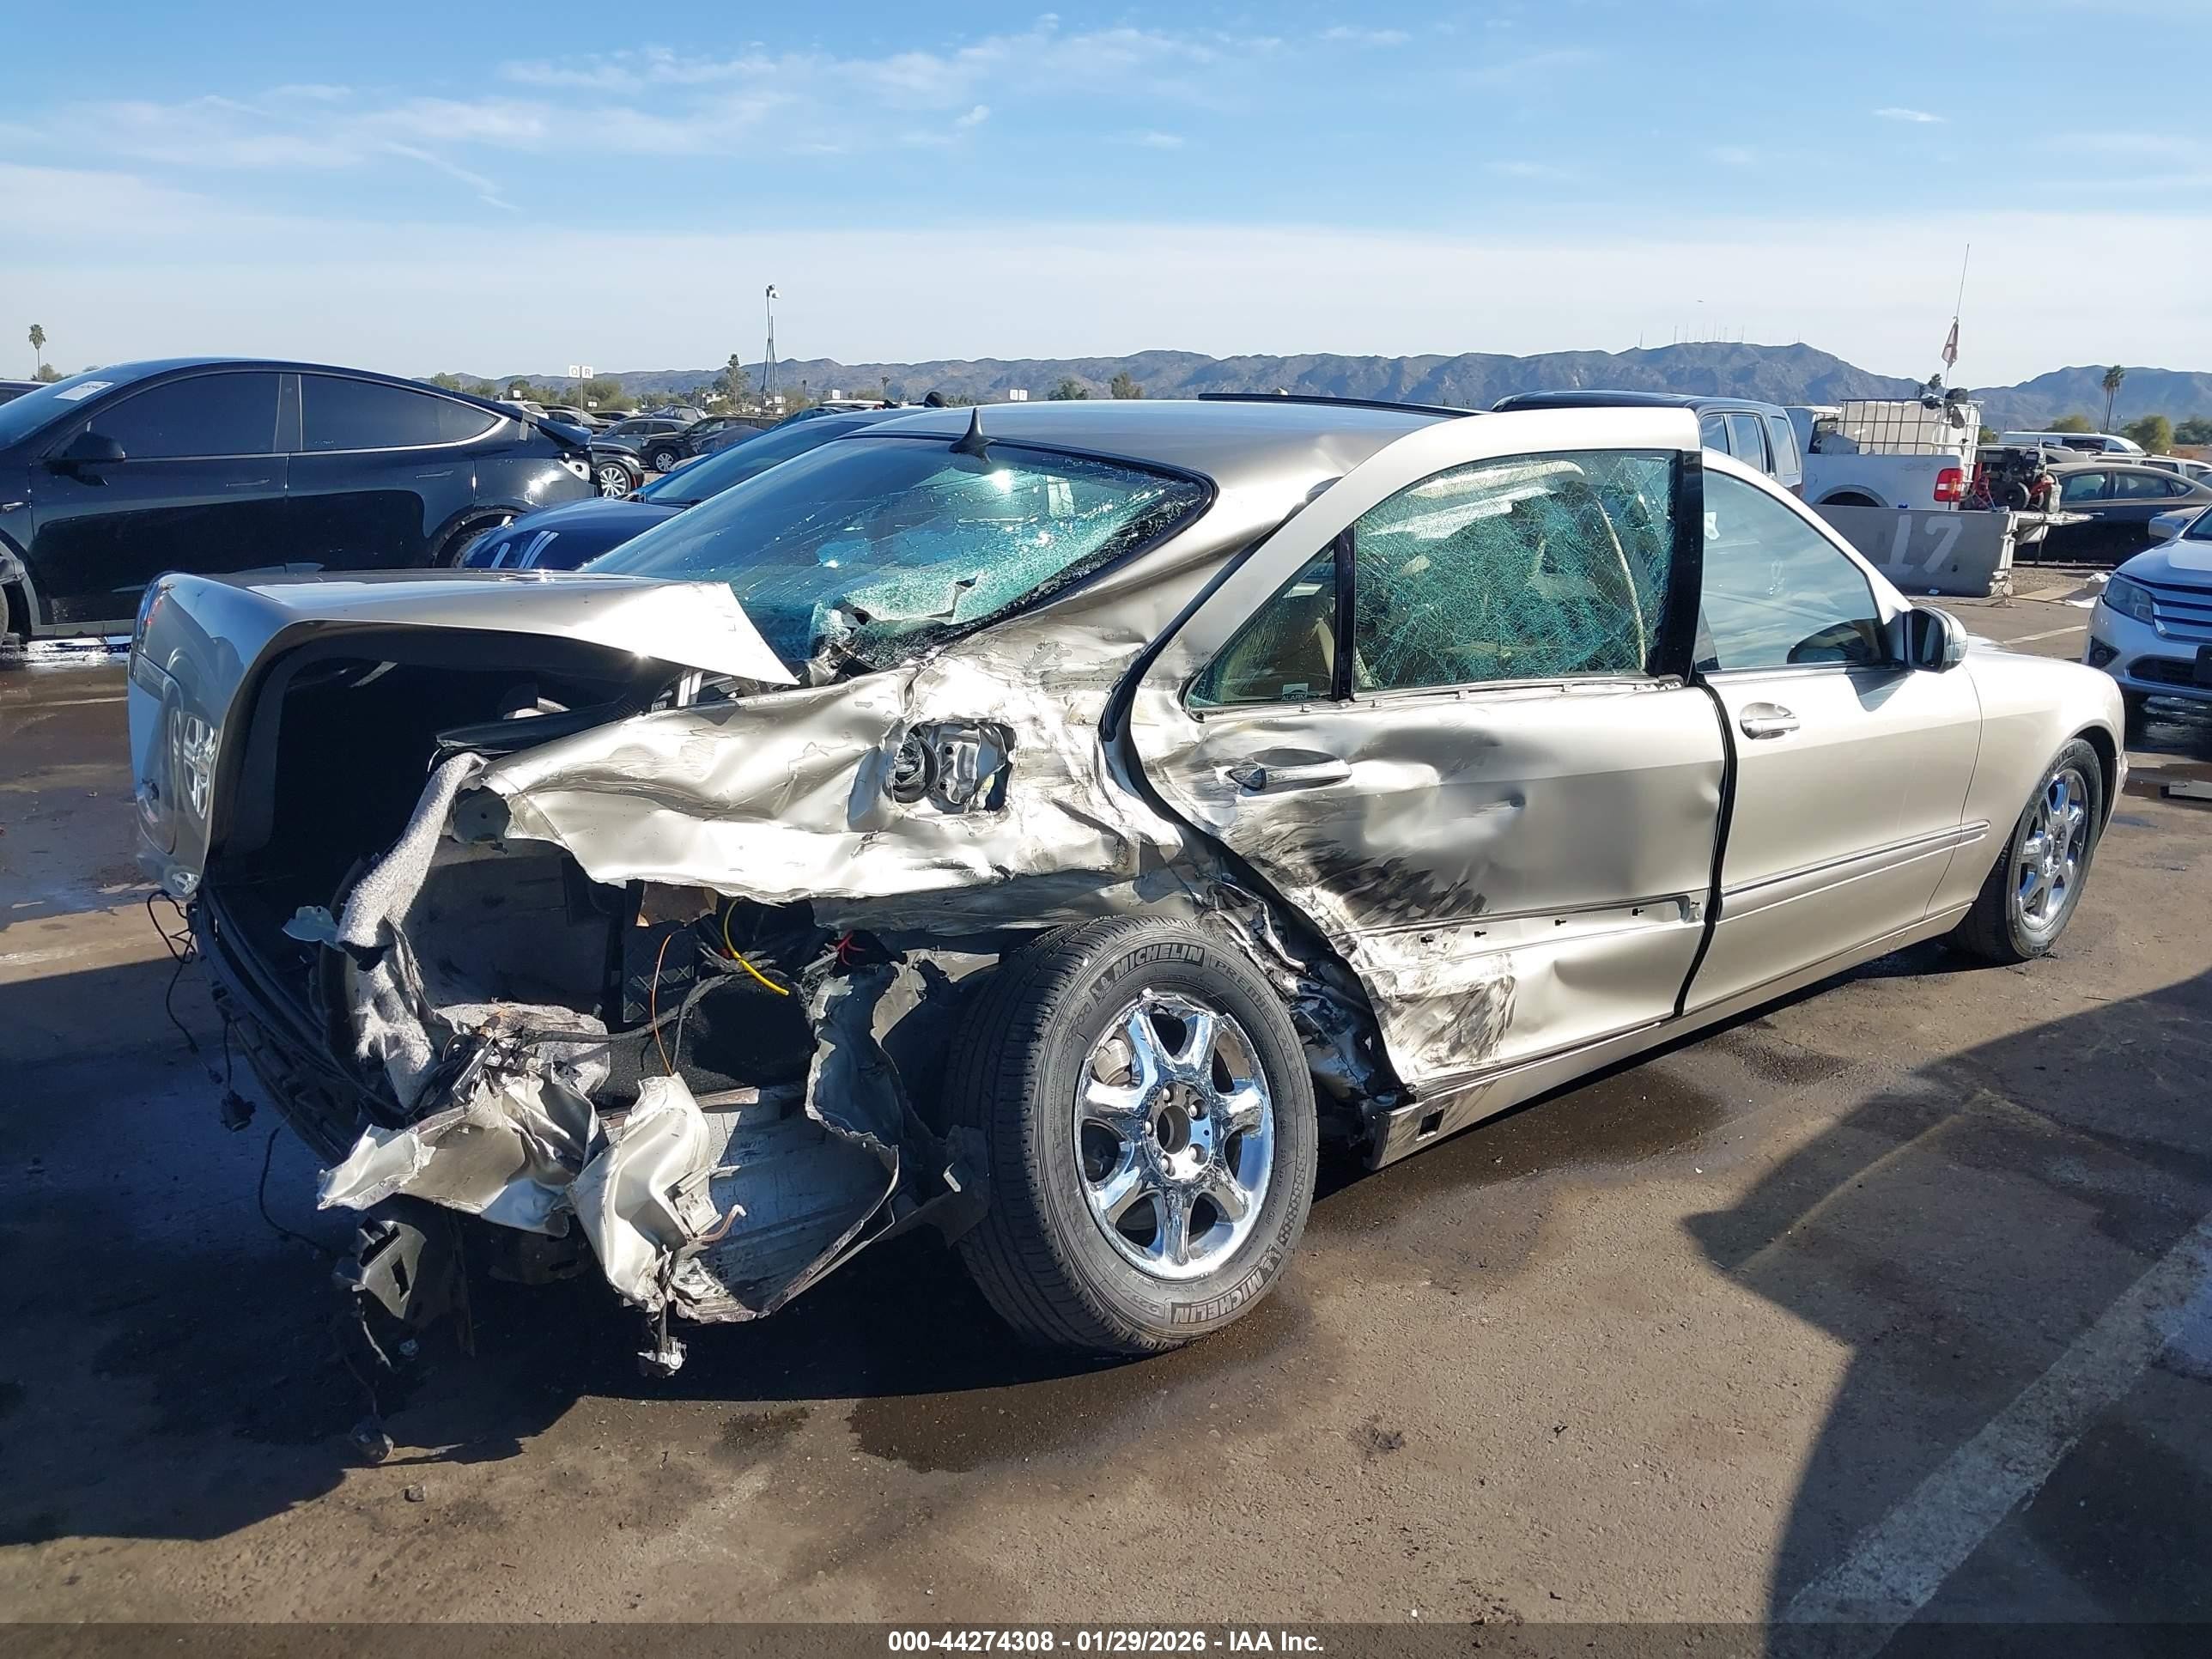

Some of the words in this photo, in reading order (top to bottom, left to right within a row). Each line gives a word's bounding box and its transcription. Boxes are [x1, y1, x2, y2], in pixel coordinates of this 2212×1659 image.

[1877, 515, 1962, 574] 17
[1113, 944, 1204, 979] MICHELIN
[1173, 1270, 1265, 1323] MICHELIN
